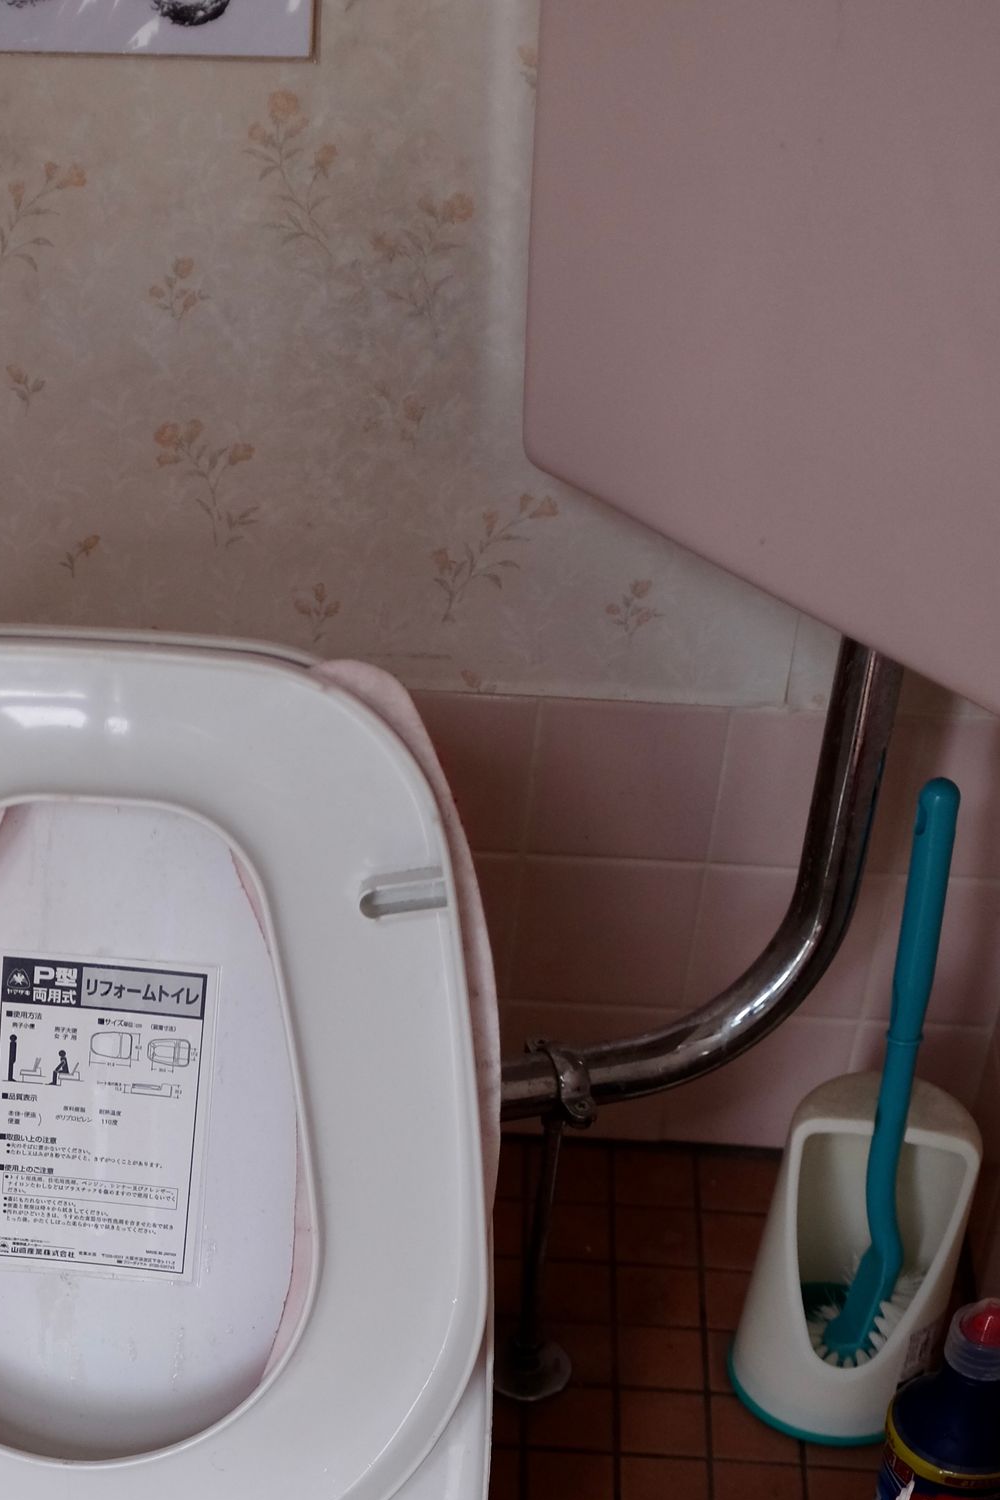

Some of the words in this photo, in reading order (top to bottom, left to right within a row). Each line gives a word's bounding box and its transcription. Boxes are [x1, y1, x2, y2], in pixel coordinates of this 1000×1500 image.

[33, 964, 77, 987] P型
[32, 987, 76, 1004] 両用式
[86, 978, 199, 1006] リフォームトイレ
[13, 1010, 42, 1020] 使用方法
[8, 1092, 37, 1102] 品質表示
[54, 1114, 92, 1123] ポリプロピレン
[101, 1118, 117, 1126] 110度
[5, 1132, 56, 1145] 取扱い上の注意
[4, 1163, 53, 1175] 使用上のご注意
